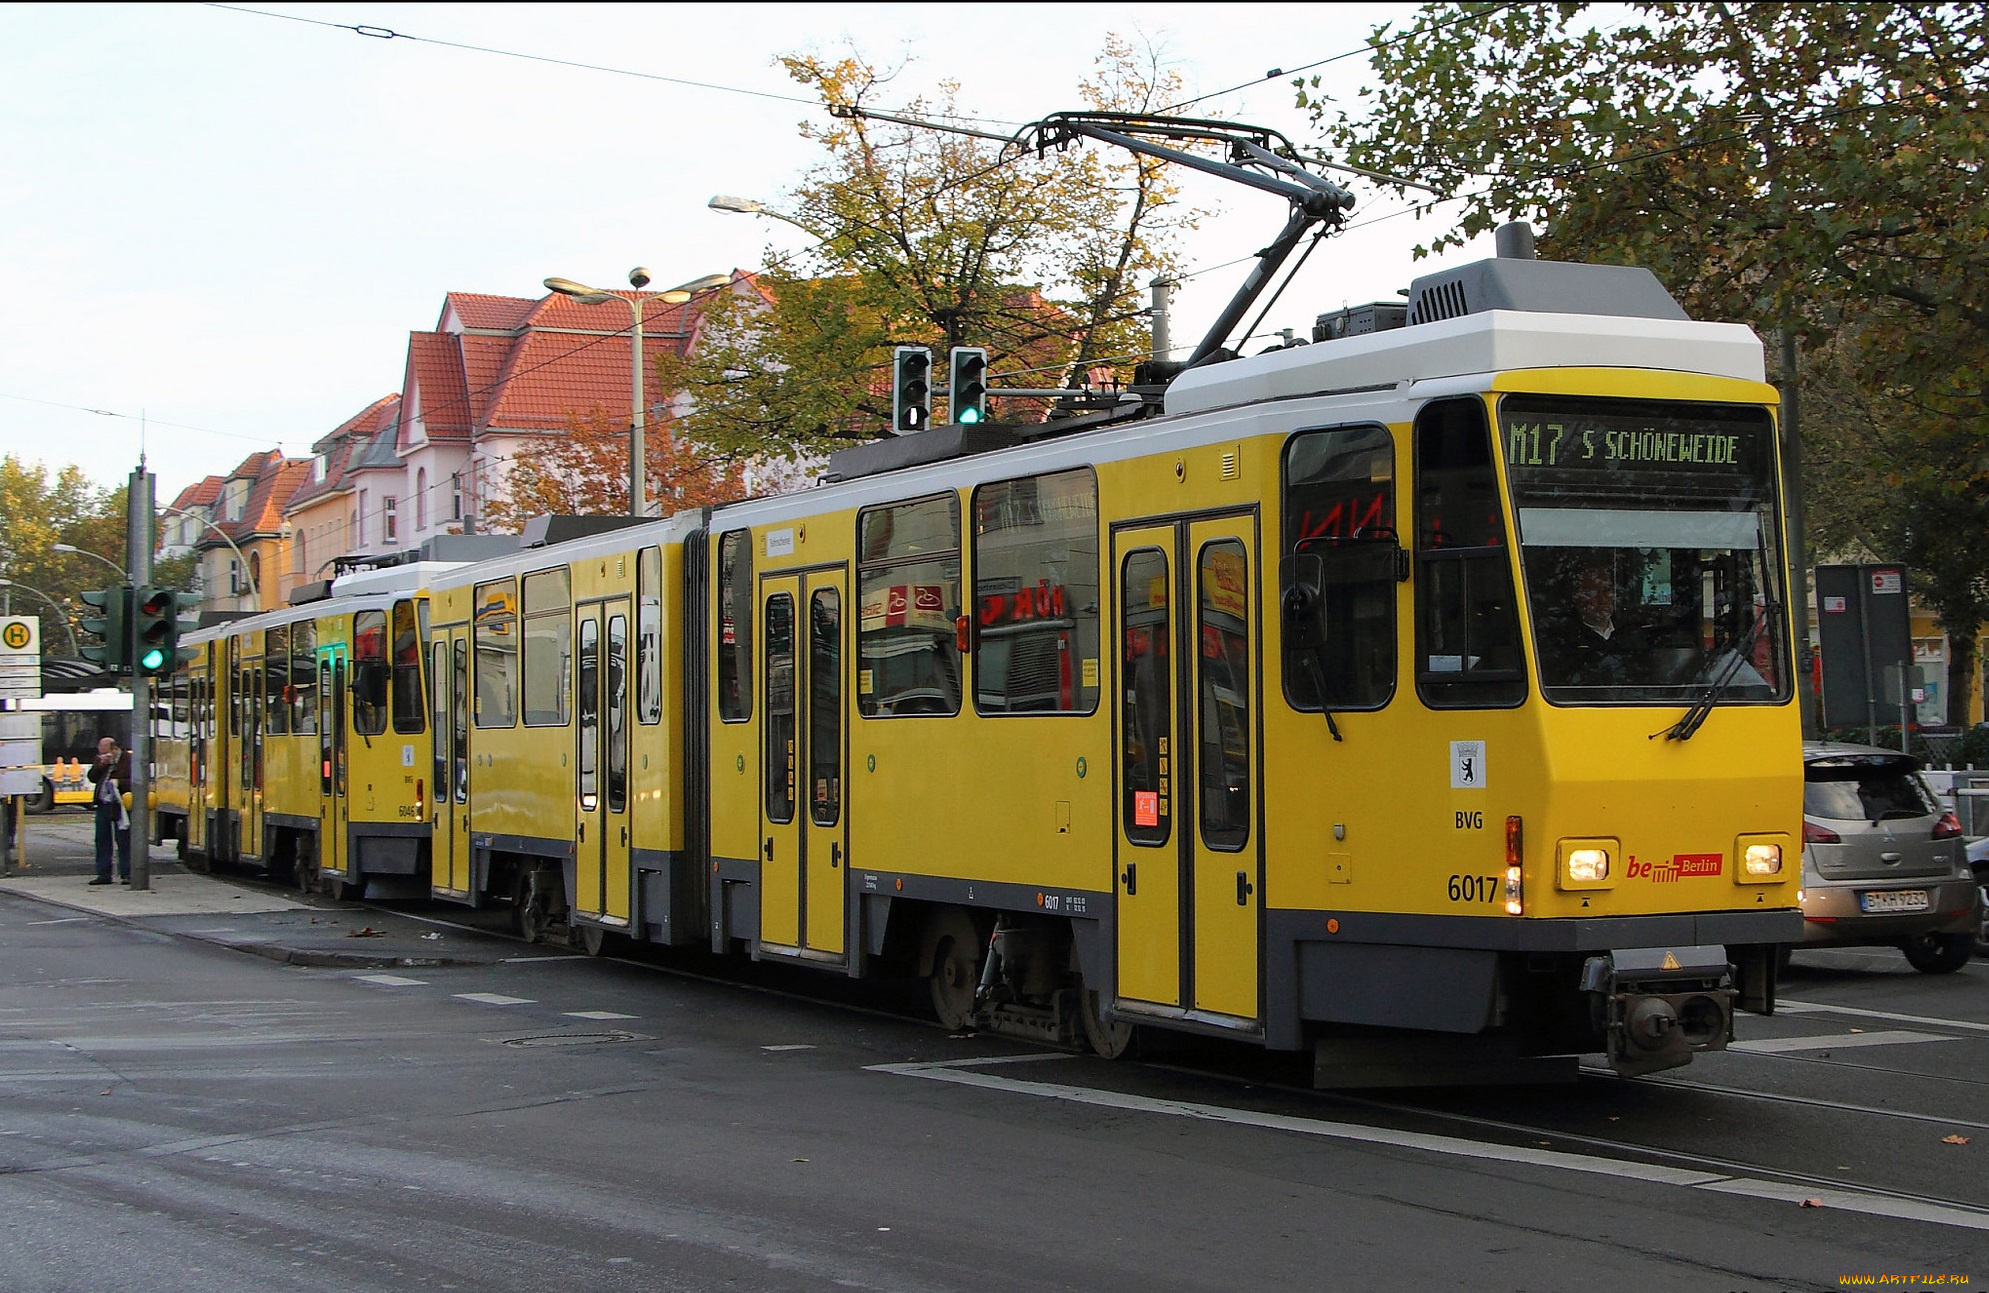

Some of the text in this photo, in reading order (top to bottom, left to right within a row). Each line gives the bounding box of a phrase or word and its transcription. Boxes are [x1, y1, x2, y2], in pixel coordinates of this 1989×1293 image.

[1509, 422, 1739, 465] M17 S SCHÖNEWEIDE
[1455, 811, 1483, 829] BVG
[1681, 859, 1718, 873] Berlin
[1447, 874, 1498, 903] 6017
[1045, 894, 1059, 910] 6017
